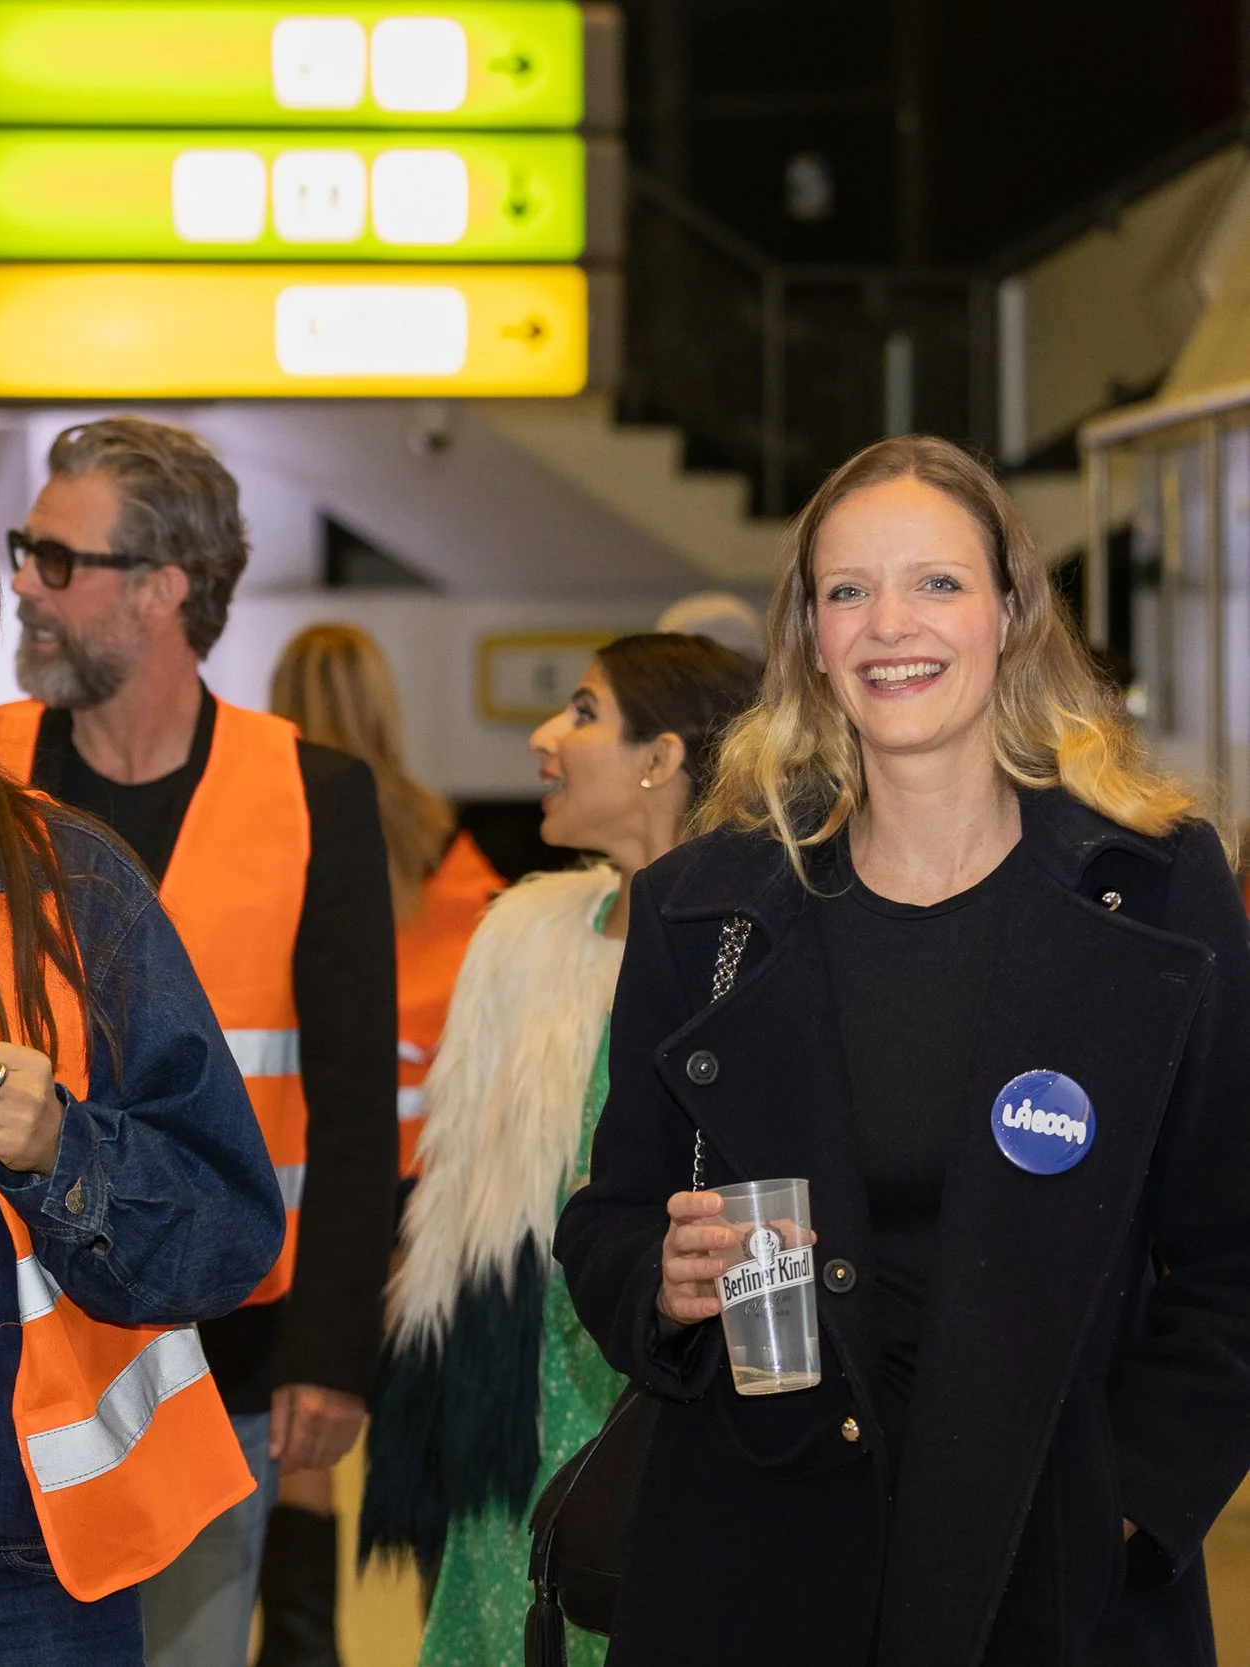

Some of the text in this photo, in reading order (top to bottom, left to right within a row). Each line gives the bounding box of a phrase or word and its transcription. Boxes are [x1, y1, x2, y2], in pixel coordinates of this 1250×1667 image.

[1002, 1098, 1087, 1145] LÅBOOM
[722, 1251, 811, 1301] Berliner Kindl
